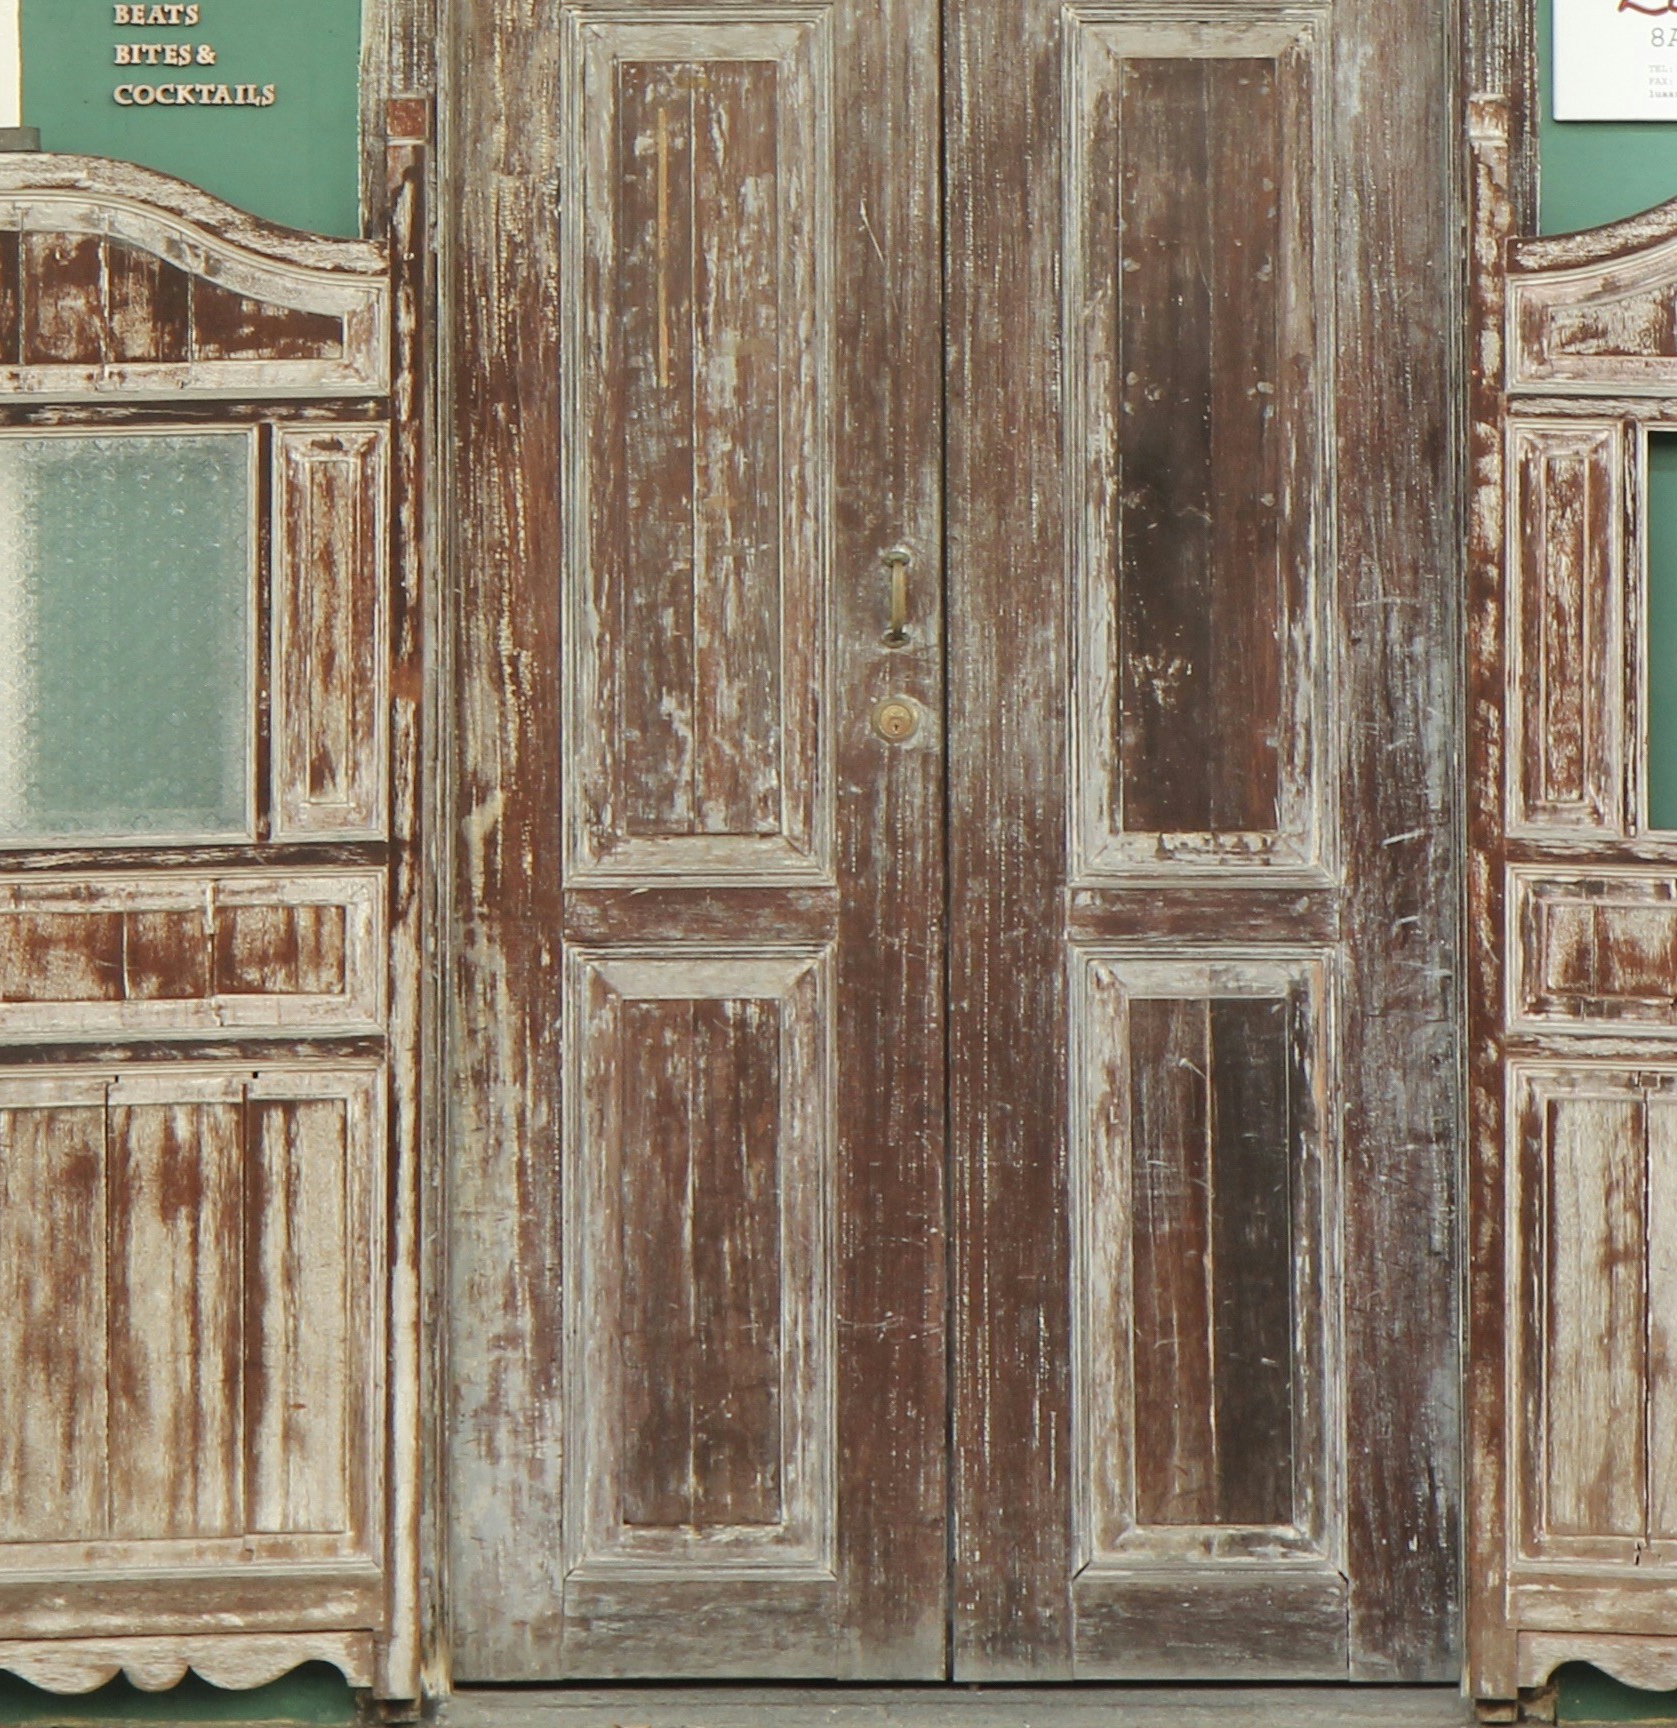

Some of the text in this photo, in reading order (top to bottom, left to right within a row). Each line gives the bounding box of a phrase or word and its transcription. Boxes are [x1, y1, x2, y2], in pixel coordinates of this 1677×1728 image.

[113, 3, 200, 27] BEATS
[113, 44, 217, 68] BITES &
[113, 83, 278, 108] COCKTAILS
